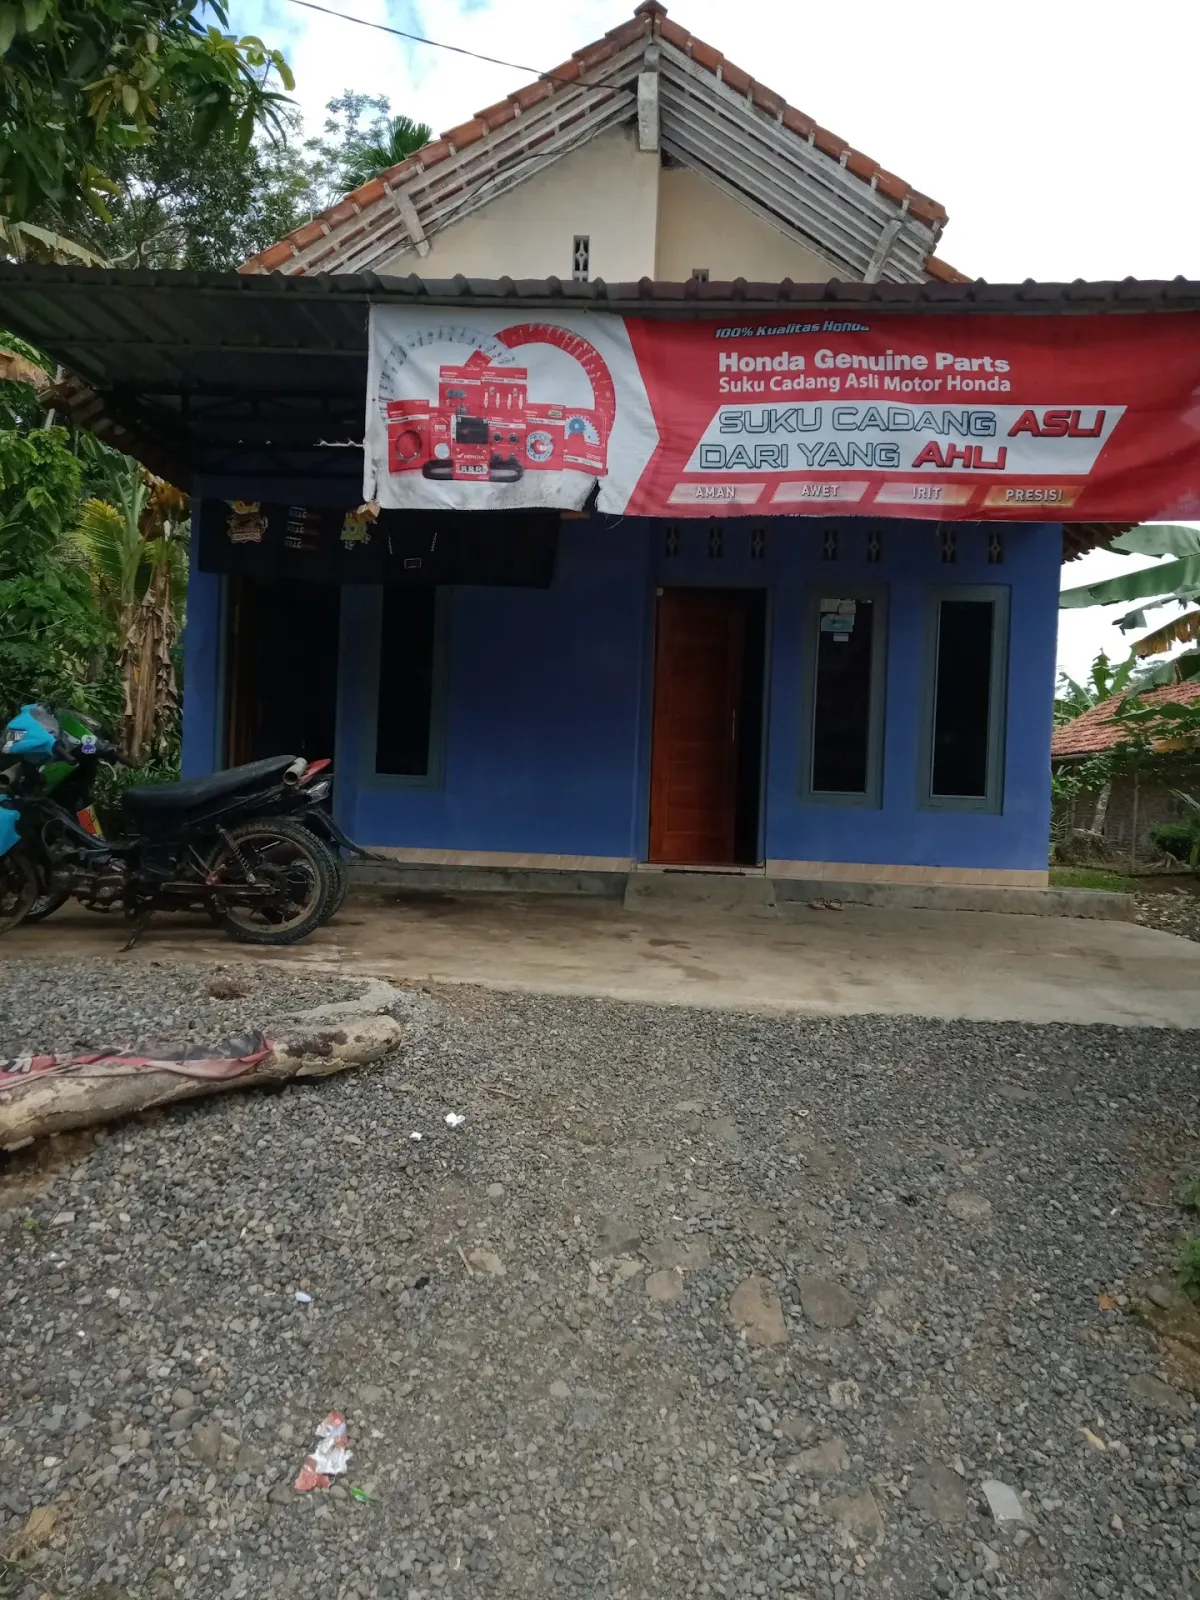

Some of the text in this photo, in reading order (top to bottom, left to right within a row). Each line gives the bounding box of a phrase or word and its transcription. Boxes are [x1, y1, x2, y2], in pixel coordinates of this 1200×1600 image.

[715, 326, 754, 339] 100%
[756, 323, 821, 336] Kualitas
[718, 348, 1011, 373] Honda Genuine Parts
[719, 372, 1012, 393] Suku Cadang Asli Motor Honda
[719, 406, 1106, 438] SUKU CADANG ASLI
[699, 440, 1008, 470] DARI YANG AHLI
[694, 485, 736, 499] AMAN
[800, 484, 840, 498] AWET
[911, 486, 942, 500] IRIT
[1005, 489, 1063, 502] PRESISI
